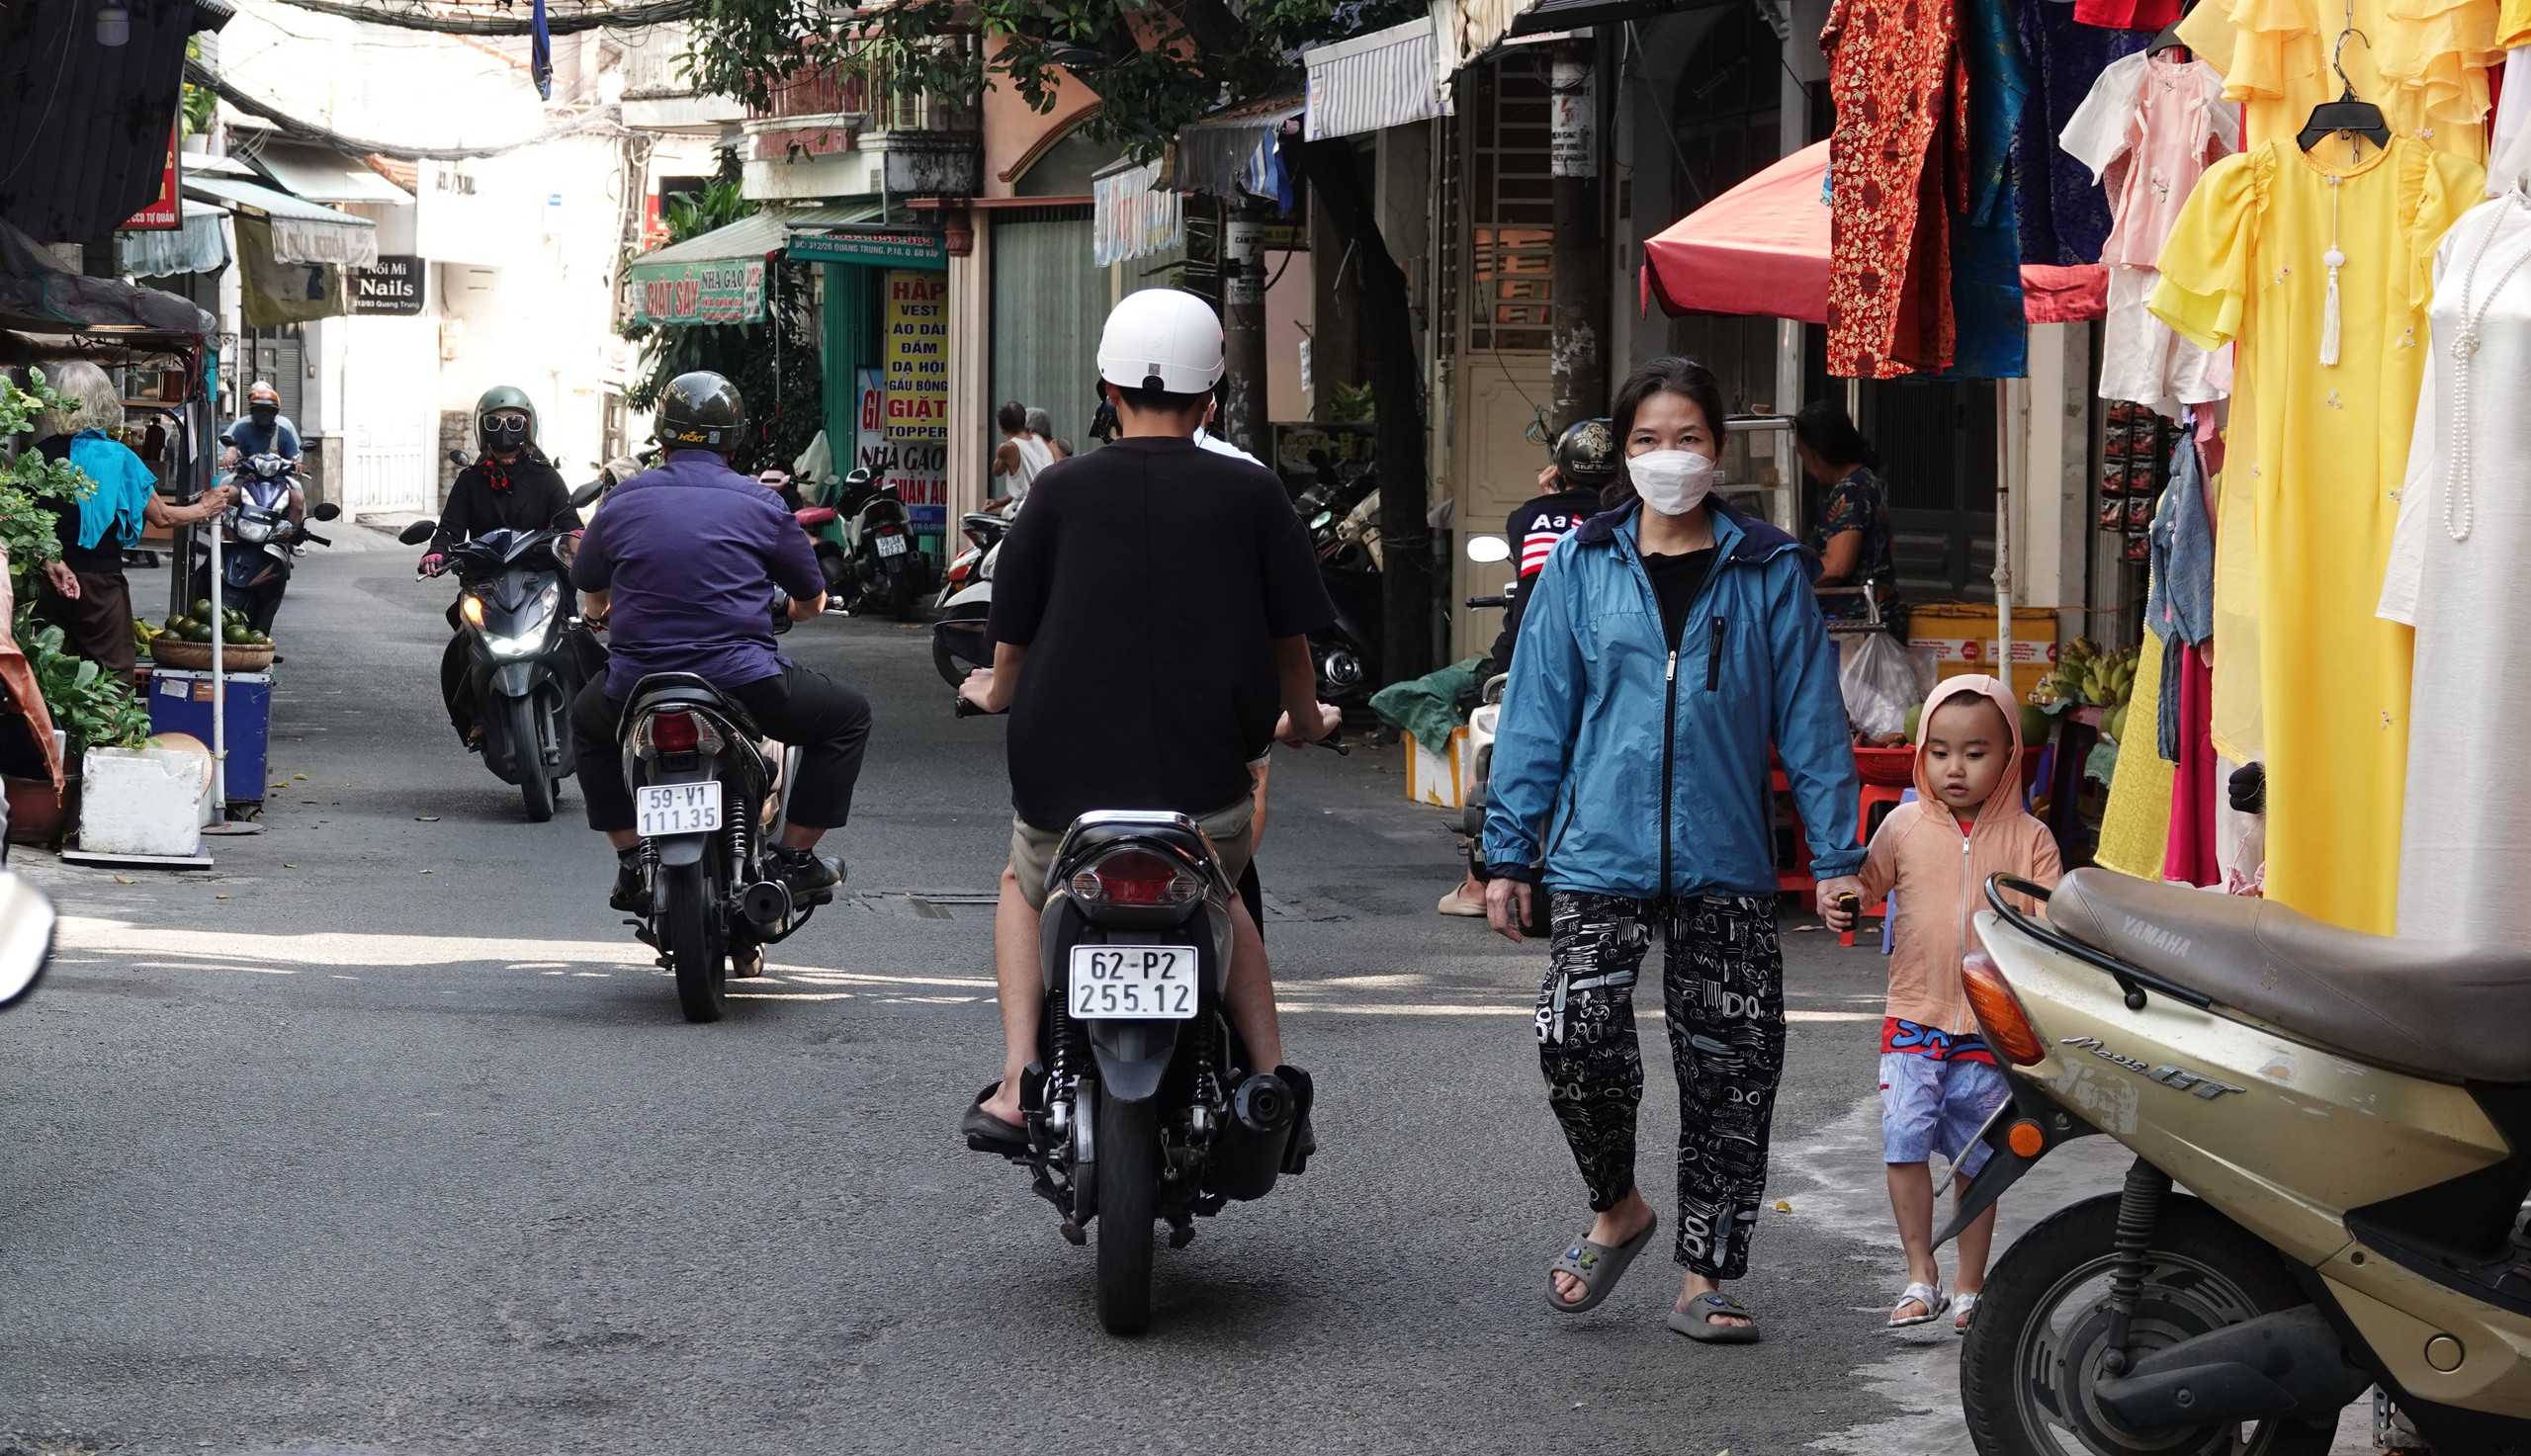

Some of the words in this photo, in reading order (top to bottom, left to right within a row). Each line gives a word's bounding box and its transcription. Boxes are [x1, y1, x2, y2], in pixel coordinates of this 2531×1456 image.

[156, 210, 175, 223] QUẢN
[833, 243, 858, 253] QUANG
[367, 262, 389, 276] Nối
[391, 263, 407, 276] Mi
[702, 266, 722, 290] NHÀ
[724, 268, 744, 293] GẠO
[359, 279, 415, 297] Nails
[675, 263, 699, 316] SẤY
[893, 275, 946, 300] HẤP
[376, 300, 398, 309] Quang
[399, 300, 420, 309] Trung
[901, 304, 940, 316] VEST
[893, 321, 915, 335] ÁO
[919, 322, 946, 336] DÀI
[892, 361, 914, 376] DẠ
[918, 359, 946, 376] HỘI
[889, 376, 913, 391] GẤU
[916, 379, 947, 392] BÔNG
[888, 395, 947, 422] GIẶT
[886, 426, 947, 437] TOPPER
[904, 446, 946, 475] GẠO
[651, 786, 705, 810] 59-V1
[643, 808, 715, 832] 111.35
[2122, 914, 2192, 958] YAMAHA
[1091, 952, 1177, 980] 62-P2
[1080, 984, 1189, 1012] 255.12
[2147, 1064, 2247, 1101] GT
